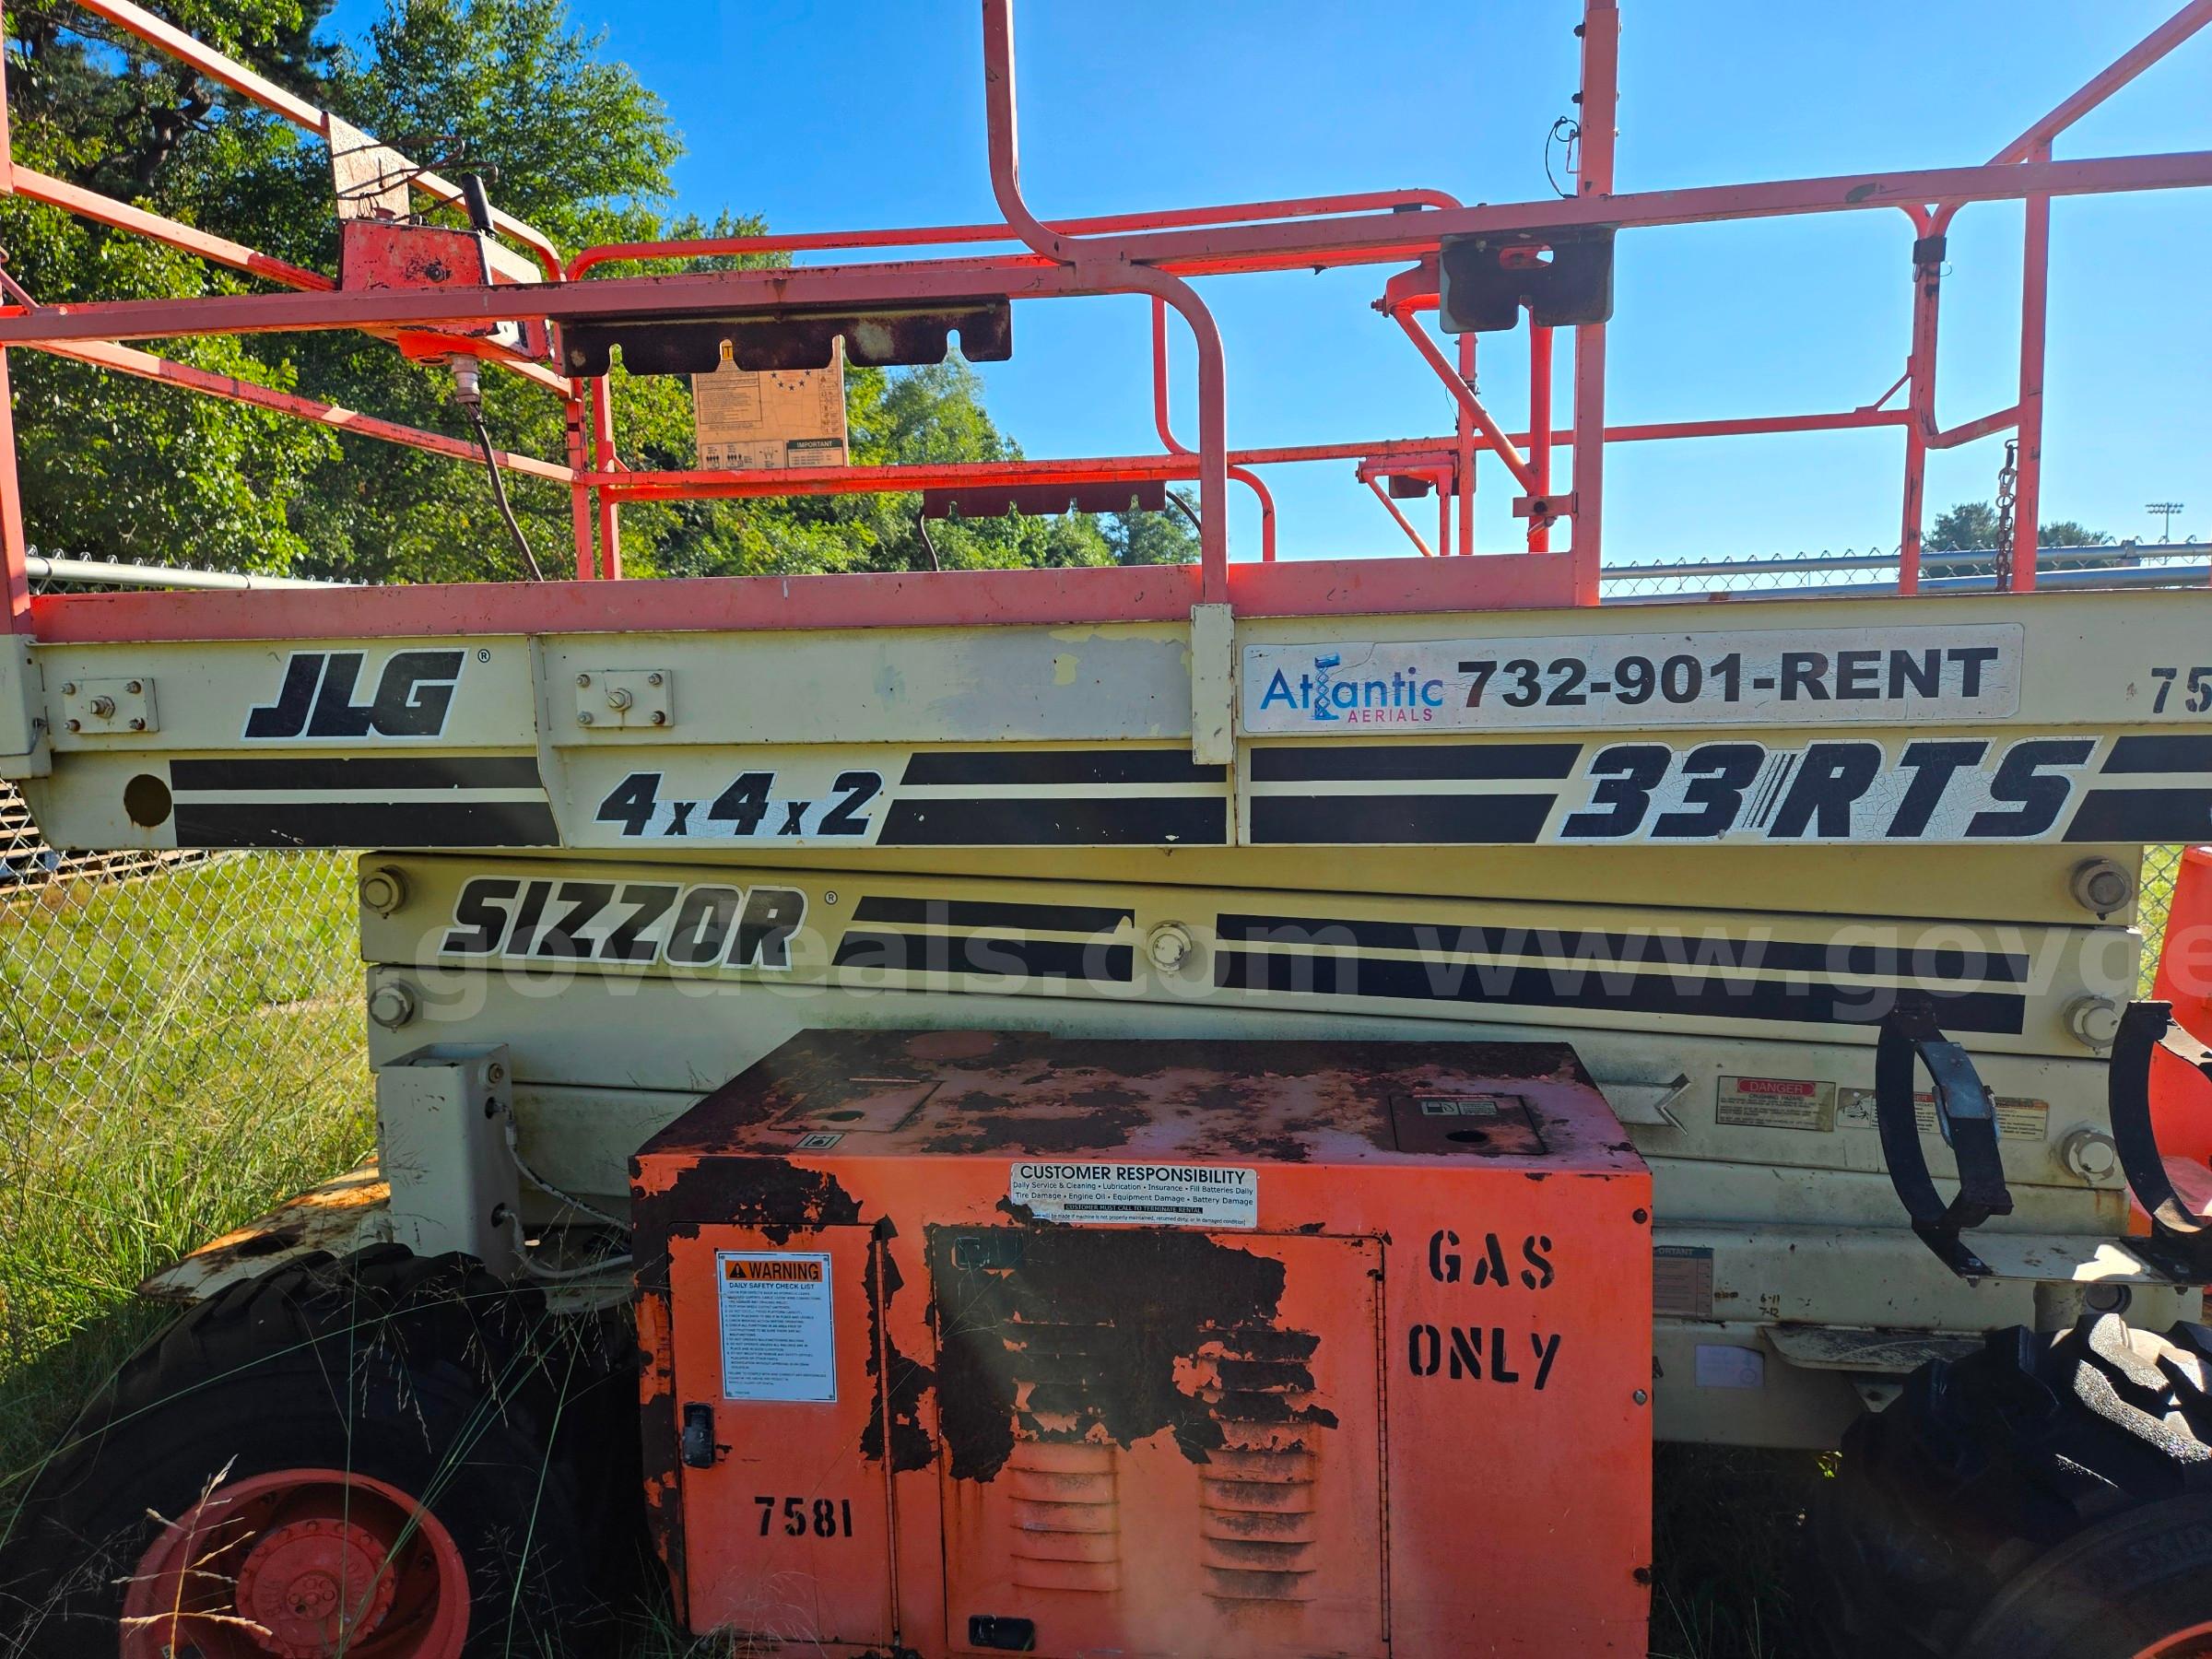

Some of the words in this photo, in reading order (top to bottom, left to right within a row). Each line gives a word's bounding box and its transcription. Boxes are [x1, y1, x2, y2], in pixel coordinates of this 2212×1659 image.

[243, 650, 467, 738] JLG
[1260, 655, 1443, 717] Atlantic
[1457, 647, 1999, 709] 732-901-RENT
[1347, 708, 1433, 724] AERIALS
[440, 877, 807, 970] SIZZOR
[1749, 1081, 1804, 1094] DANGER
[1020, 1165, 1111, 1180] CUSTOMER
[1116, 1167, 1246, 1184] RESPONSIBILITY
[1066, 1182, 1097, 1191] Cleaning
[1147, 1183, 1183, 1192] Insurance
[1202, 1186, 1234, 1194] Batteries
[1235, 1187, 1253, 1196] Daily
[1031, 1193, 1062, 1201] Damage
[1068, 1193, 1094, 1201] Engine
[1112, 1194, 1152, 1202] Equipment
[1154, 1194, 1185, 1204] Damage
[1193, 1195, 1220, 1205] Battery
[1222, 1197, 1253, 1206] Damage
[748, 1261, 819, 1281] WARNING
[1429, 1230, 1556, 1290] GAS
[1408, 1324, 1562, 1391] ONLY
[754, 1496, 853, 1538] 7581
